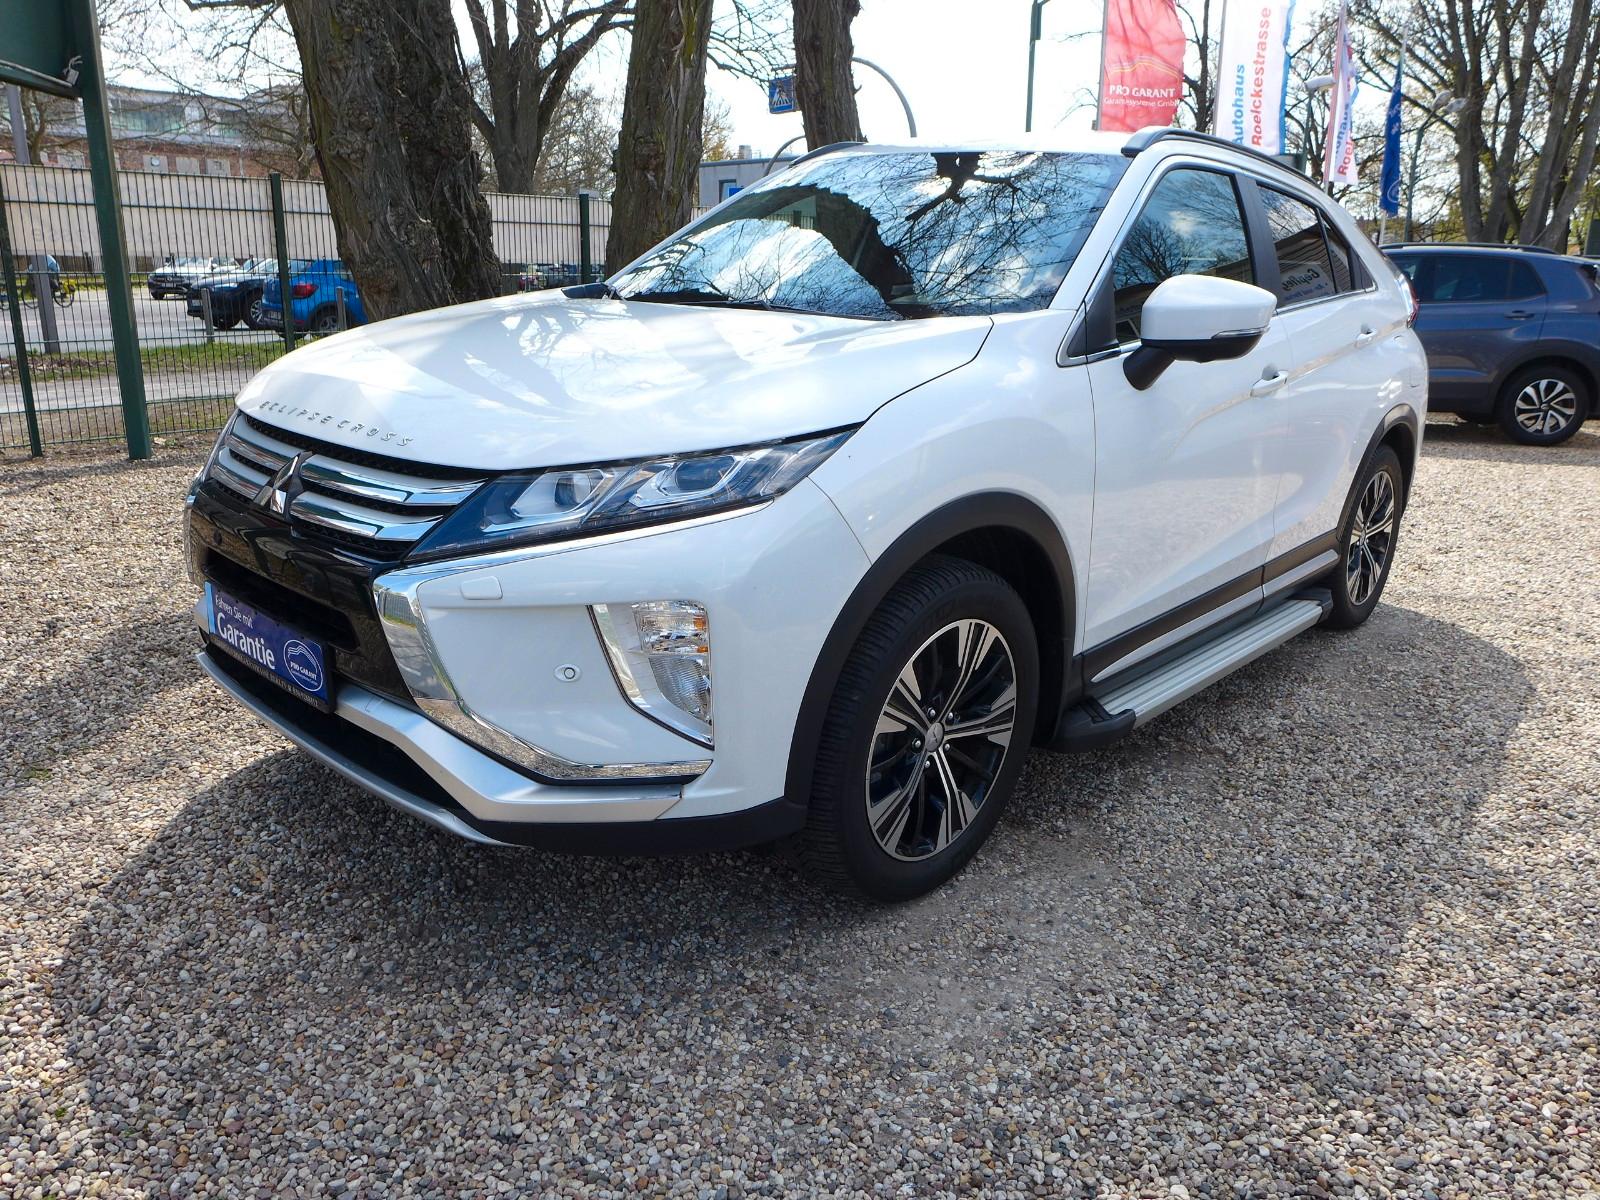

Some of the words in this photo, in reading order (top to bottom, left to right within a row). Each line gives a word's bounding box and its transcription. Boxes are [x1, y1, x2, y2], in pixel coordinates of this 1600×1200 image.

[1109, 85, 1130, 96] PRO
[1131, 87, 1176, 98] GARANT
[1250, 7, 1271, 146] Roelckestrasse
[1231, 64, 1245, 145] Autohaus
[259, 401, 334, 424] ECLIPSE
[337, 420, 414, 446] CROSS
[217, 612, 276, 670] Garantie
[233, 606, 242, 622] Sie
[242, 614, 254, 629] mit
